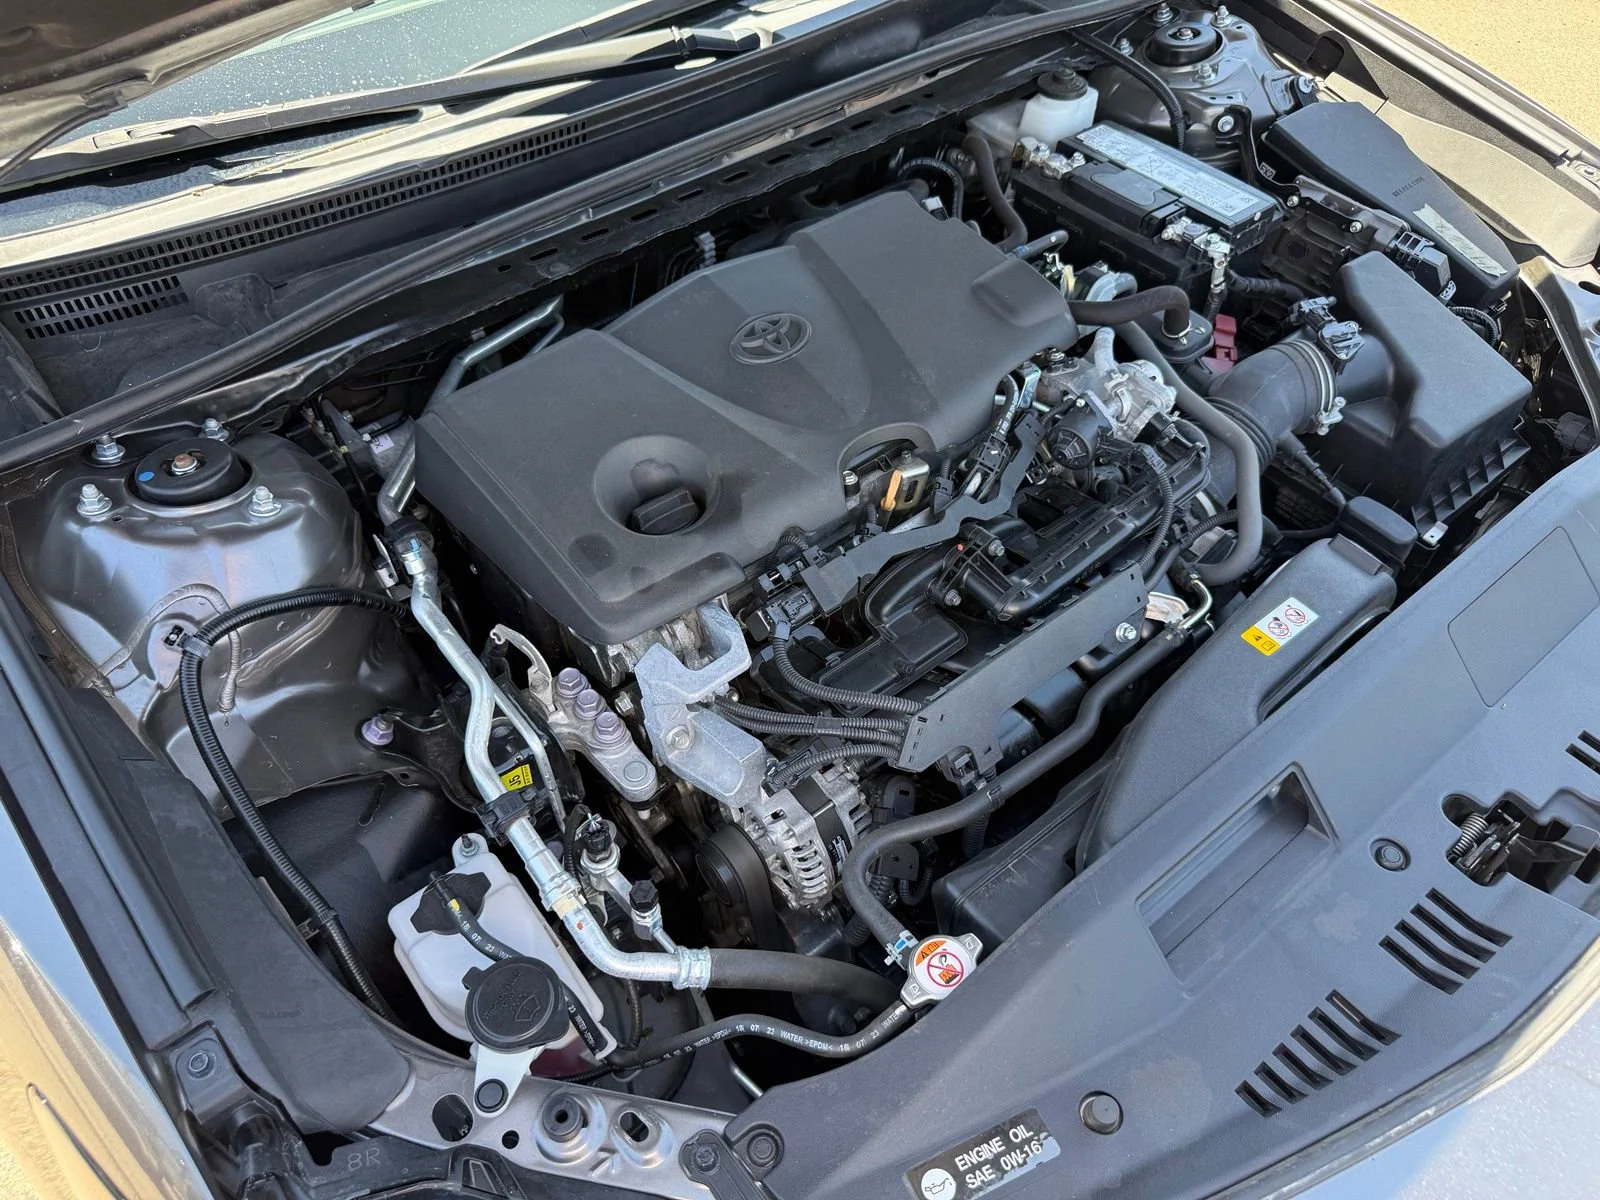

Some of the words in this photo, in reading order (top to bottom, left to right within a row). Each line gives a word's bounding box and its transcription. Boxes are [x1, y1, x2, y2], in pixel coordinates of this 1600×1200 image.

[485, 943, 495, 953] 23
[766, 1026, 775, 1035] 23
[780, 1029, 804, 1045] WATER
[870, 1029, 880, 1039] 23
[954, 1136, 1006, 1172] ENGINE
[1009, 1124, 1034, 1143] OIL
[965, 1164, 996, 1189] SAE
